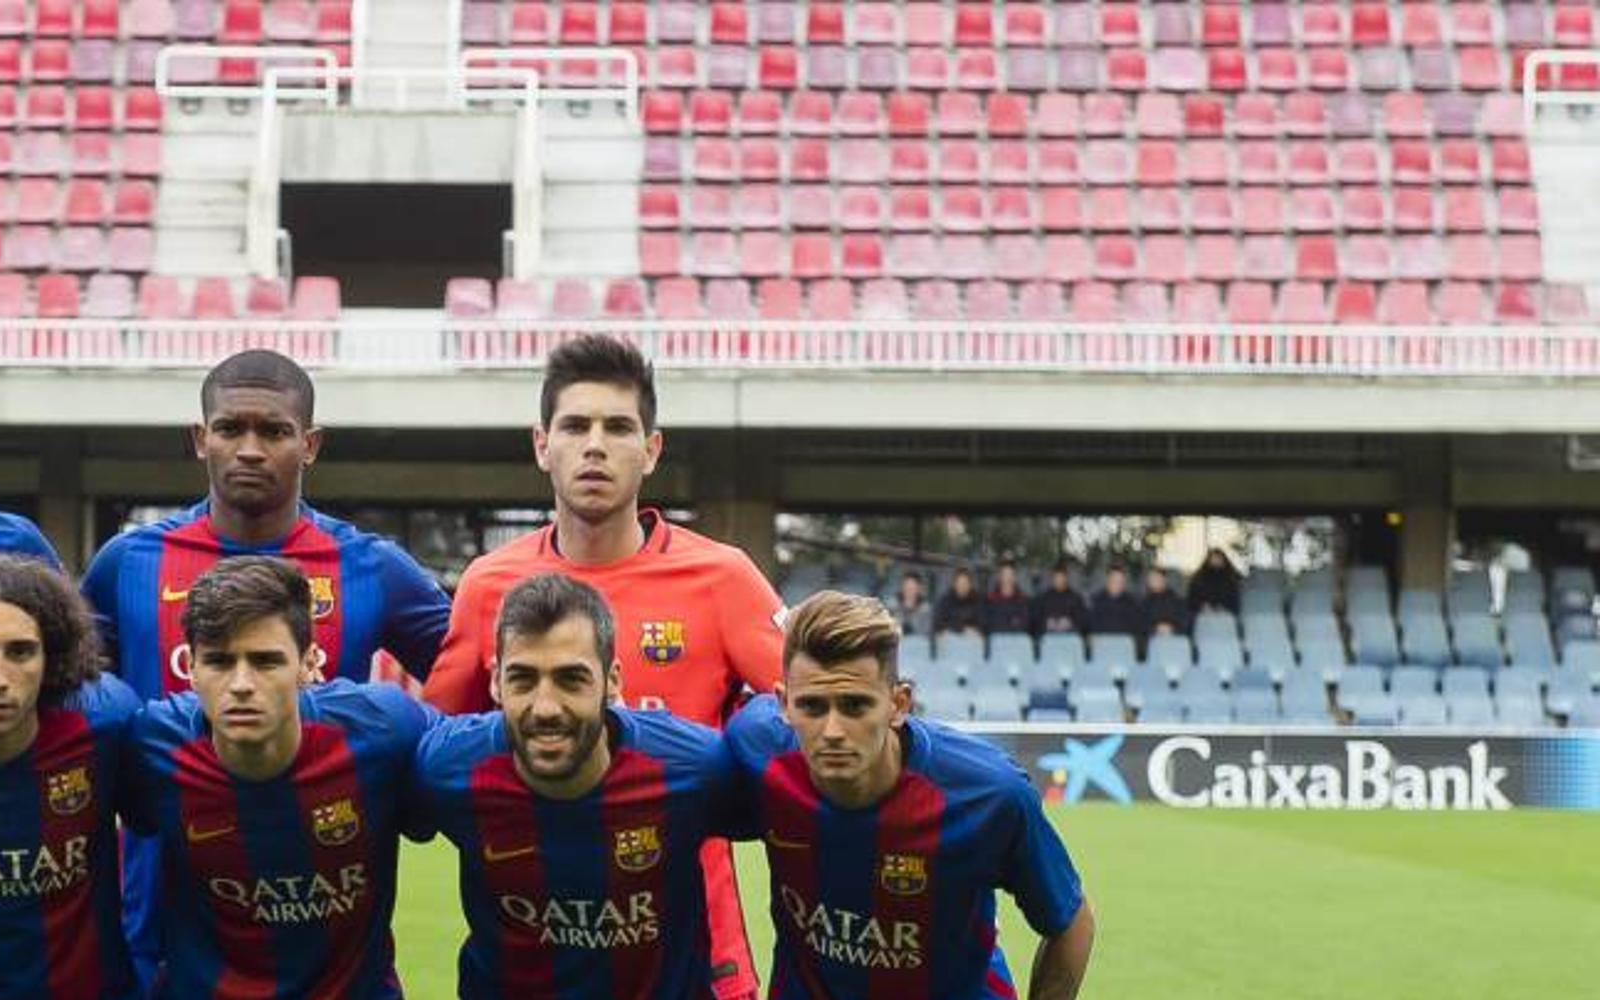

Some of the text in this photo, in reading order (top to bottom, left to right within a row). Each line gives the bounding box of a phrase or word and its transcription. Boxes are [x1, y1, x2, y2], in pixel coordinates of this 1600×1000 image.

[1147, 736, 1513, 812] CaixaBank
[209, 863, 367, 907] QATAR
[252, 890, 366, 922] AIRWAY
[500, 890, 657, 928] QATAR
[781, 886, 920, 950] QATAR
[539, 920, 659, 949] AIRWAYS
[805, 929, 923, 970] AIRWAYS
